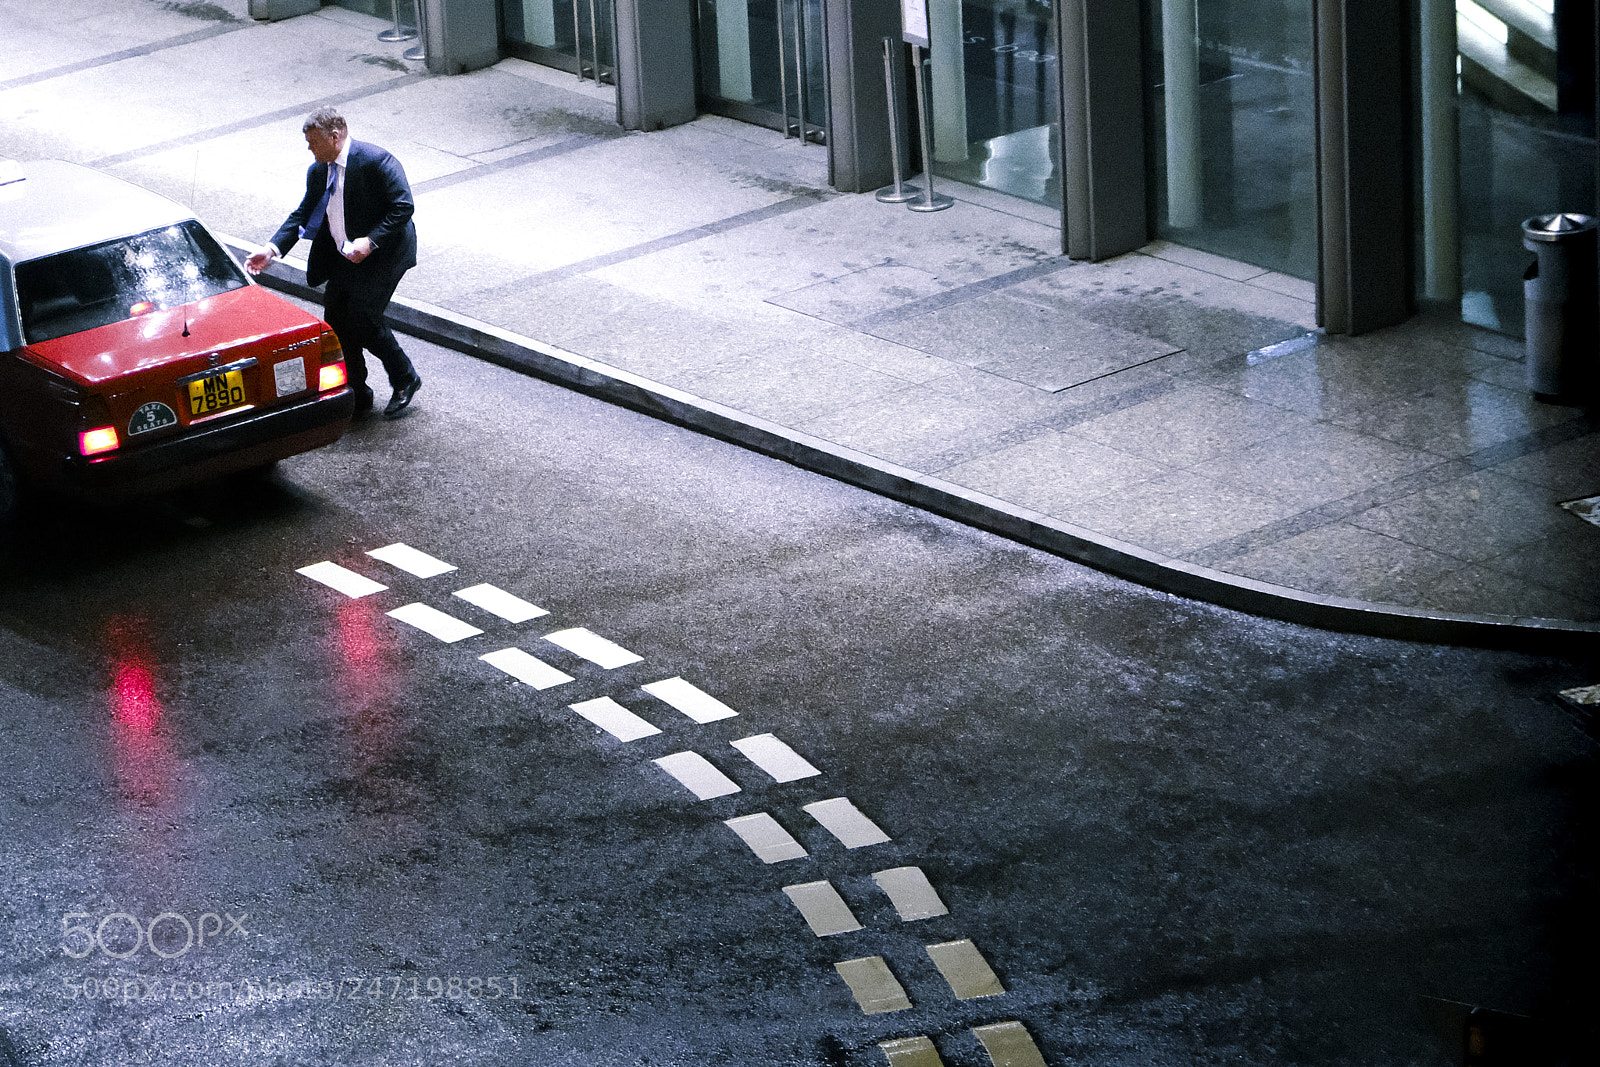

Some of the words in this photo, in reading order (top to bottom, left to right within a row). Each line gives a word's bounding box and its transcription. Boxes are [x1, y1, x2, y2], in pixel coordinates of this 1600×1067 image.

[203, 373, 228, 394] MN
[193, 387, 242, 412] 7890
[139, 404, 160, 414] TAXI
[146, 411, 156, 422] 5
[137, 418, 167, 431] SEATS
